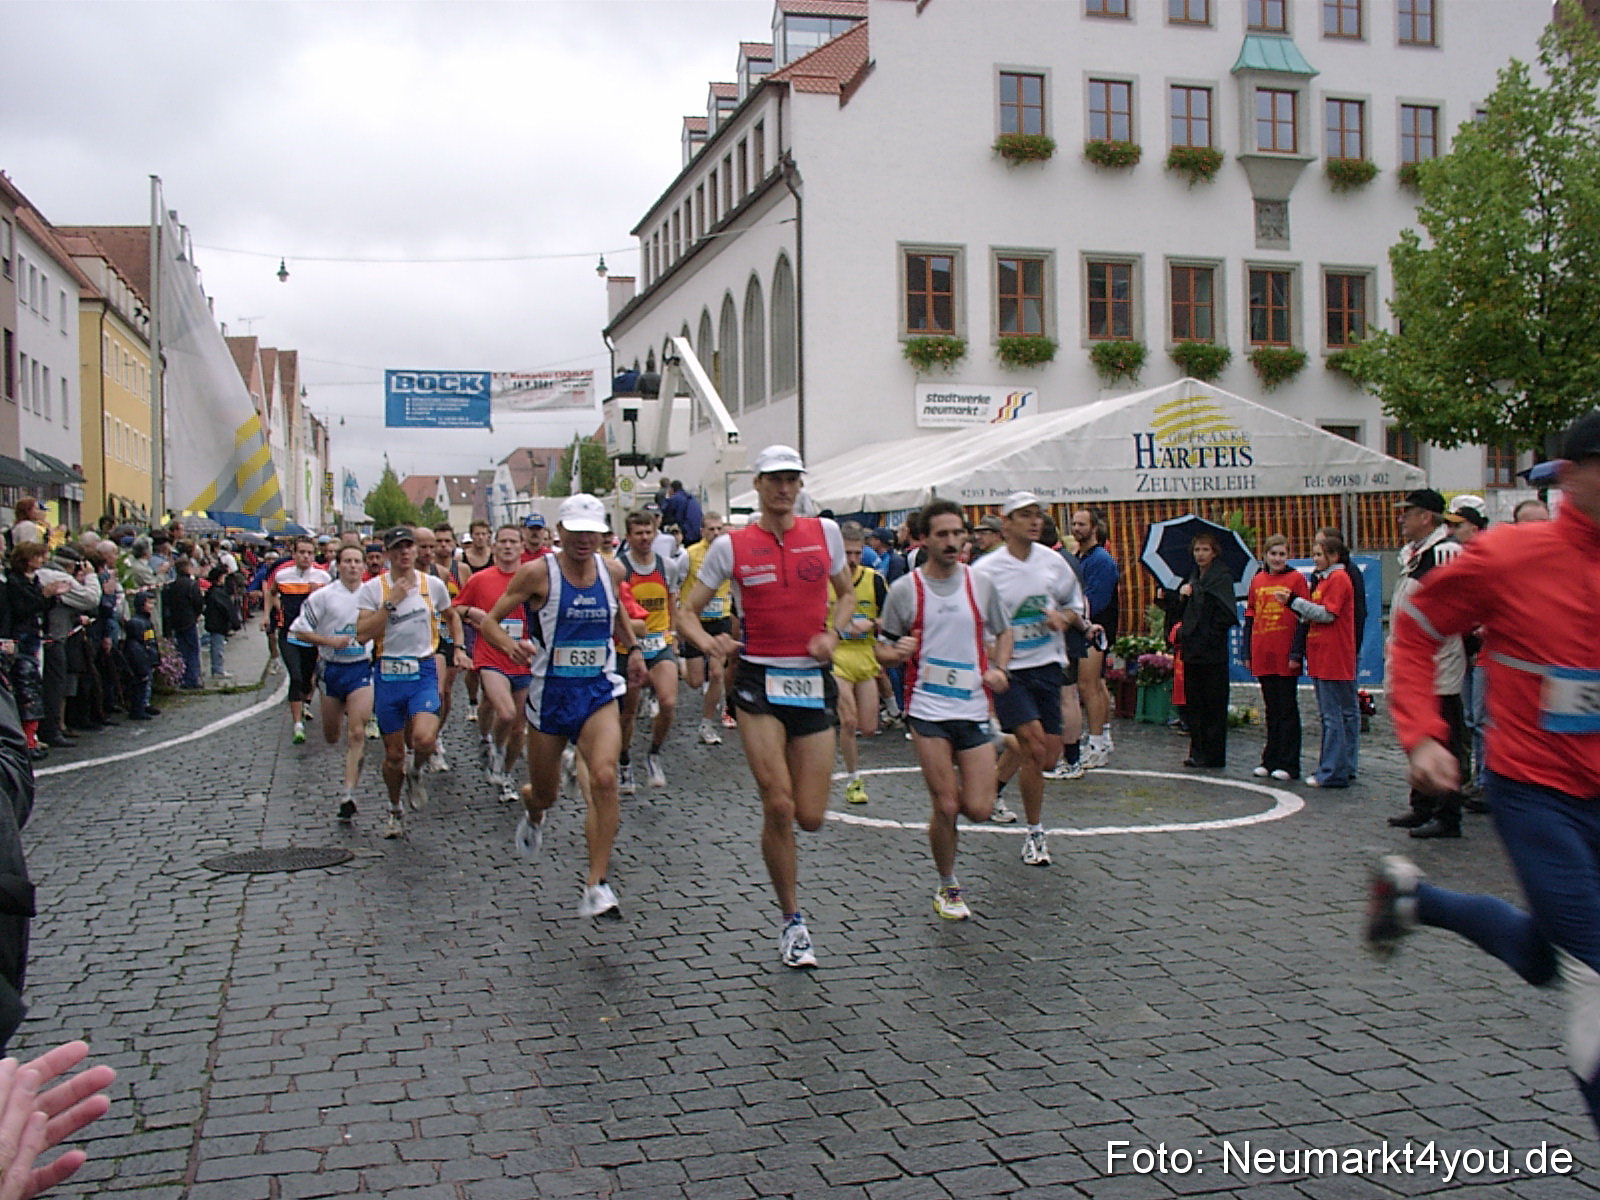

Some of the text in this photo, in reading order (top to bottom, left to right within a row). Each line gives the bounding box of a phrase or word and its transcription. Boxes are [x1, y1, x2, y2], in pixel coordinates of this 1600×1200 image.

[390, 371, 485, 394] BOCK
[925, 393, 991, 405] stadtwerke
[923, 405, 979, 416] neumarkt
[570, 650, 596, 666] 638
[392, 662, 411, 674] 571
[947, 669, 958, 685] 6
[783, 679, 812, 696] 630
